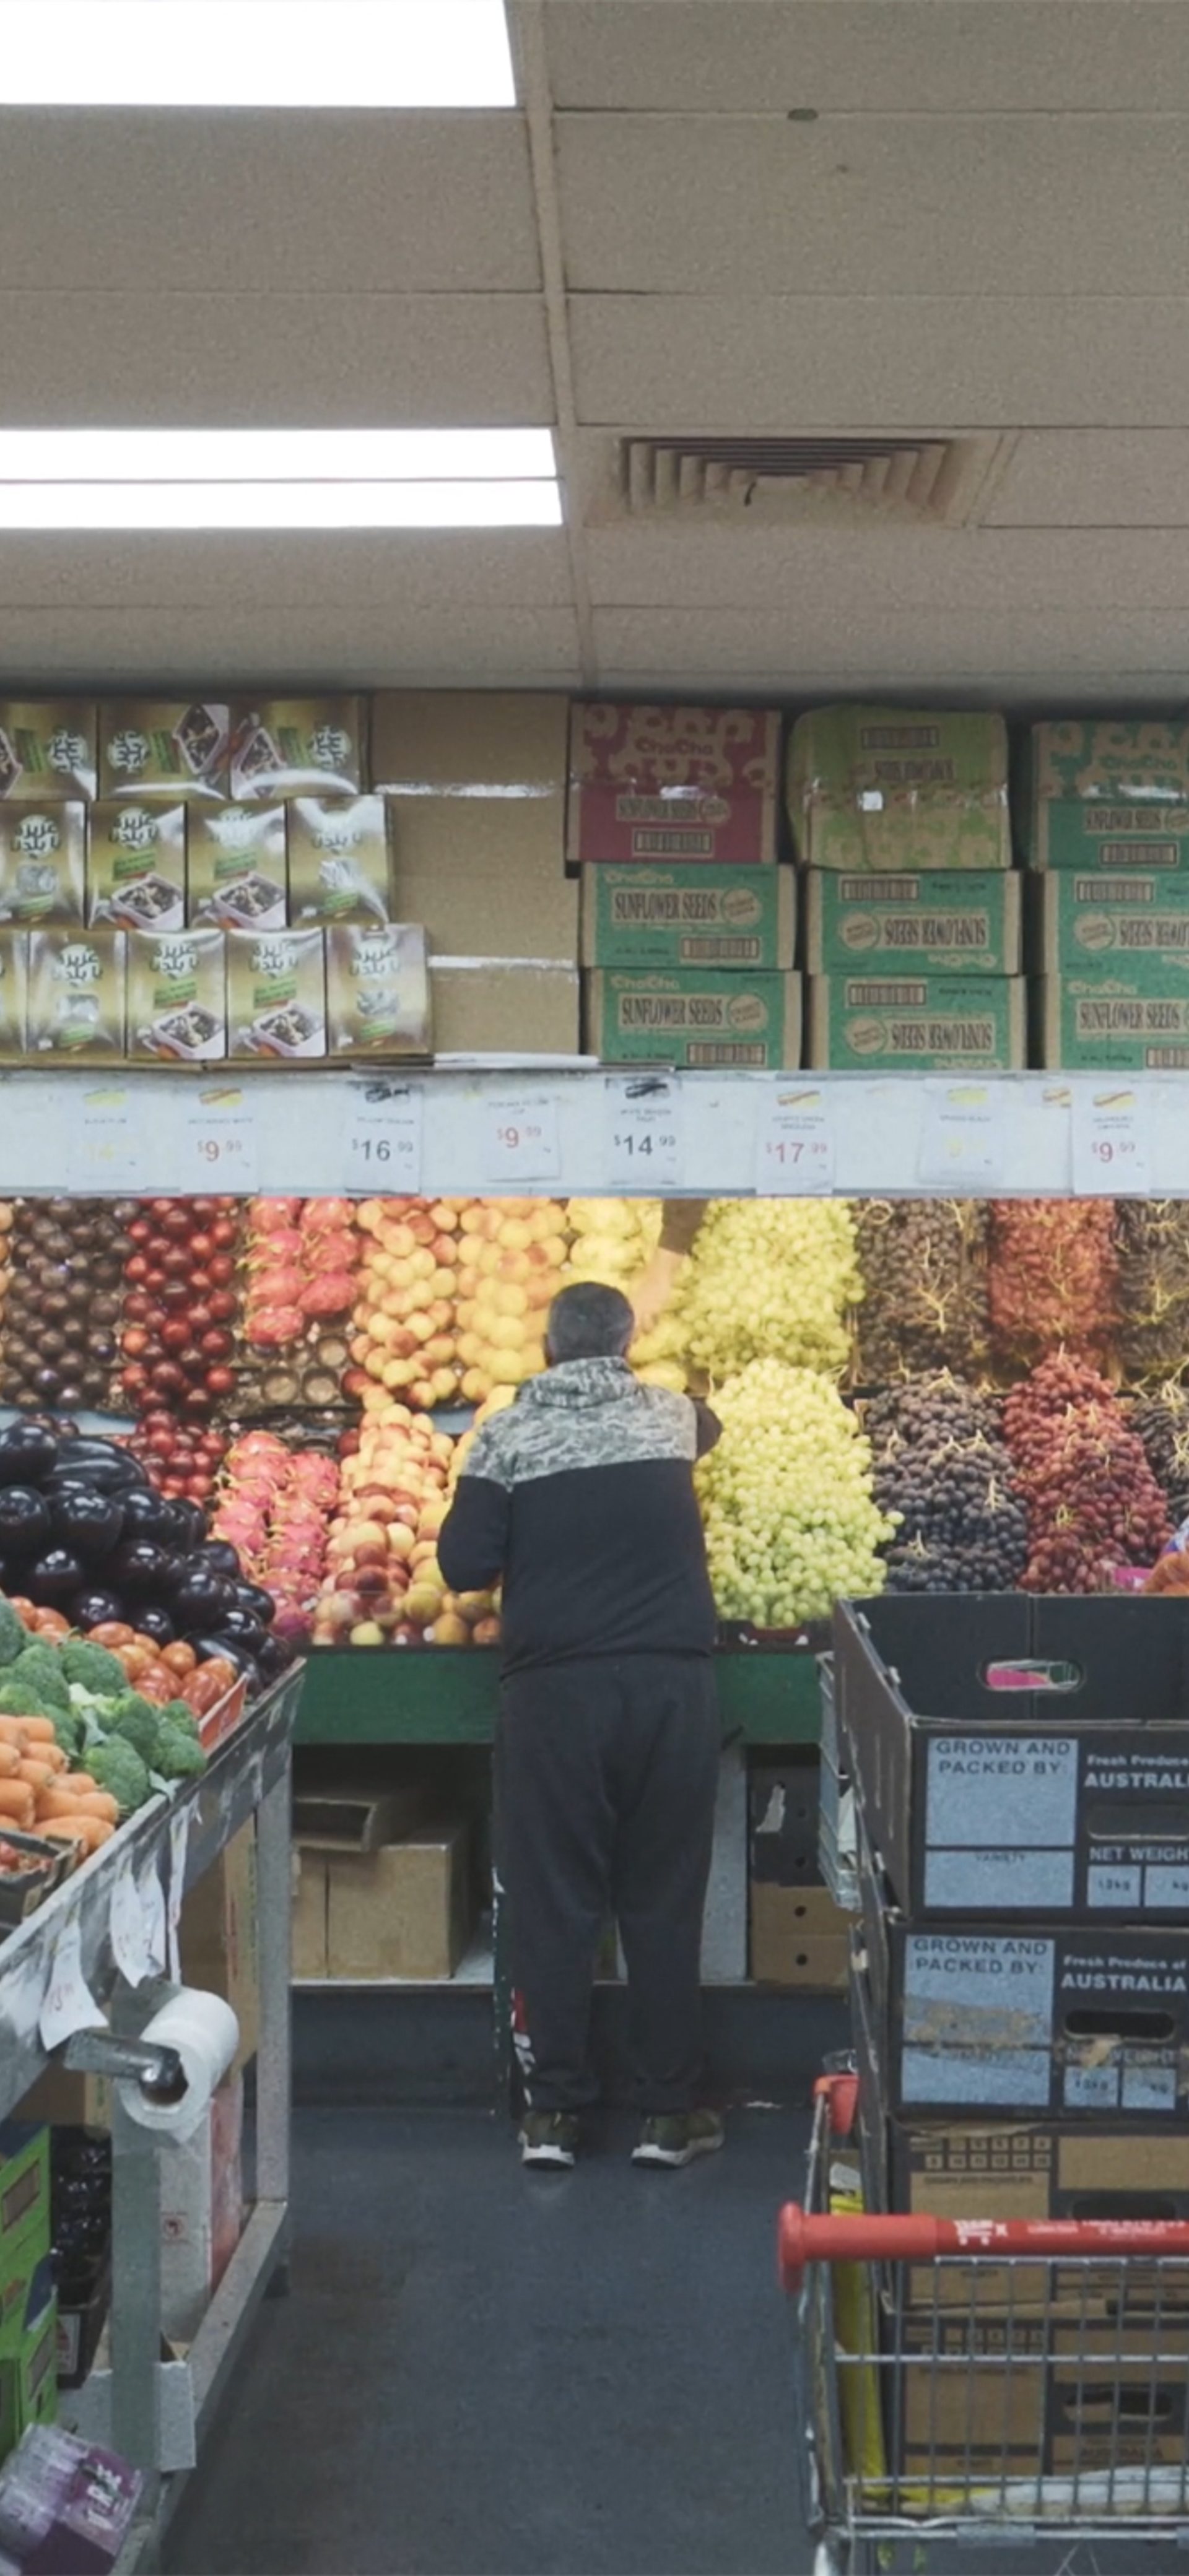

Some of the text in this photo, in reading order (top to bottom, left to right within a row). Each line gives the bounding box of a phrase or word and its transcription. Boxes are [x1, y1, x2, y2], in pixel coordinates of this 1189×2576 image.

[614, 892, 680, 920] SUNFLOWER
[682, 892, 717, 920] SEEDS
[622, 999, 686, 1025] SUNFLOWER
[688, 999, 723, 1025] SEEDS
[936, 1740, 1071, 1756] GROWN AND
[938, 1759, 1026, 1775] PACKED
[1087, 1754, 1189, 1766] Fresh Produce
[1089, 1846, 1189, 1862] NET WEIGH
[913, 1938, 1048, 1956] GROWN AND
[915, 1957, 1003, 1974] PACKED
[1063, 1954, 1187, 1970] Fresh Produce of
[1060, 1972, 1188, 1992] AUSTRALIA
